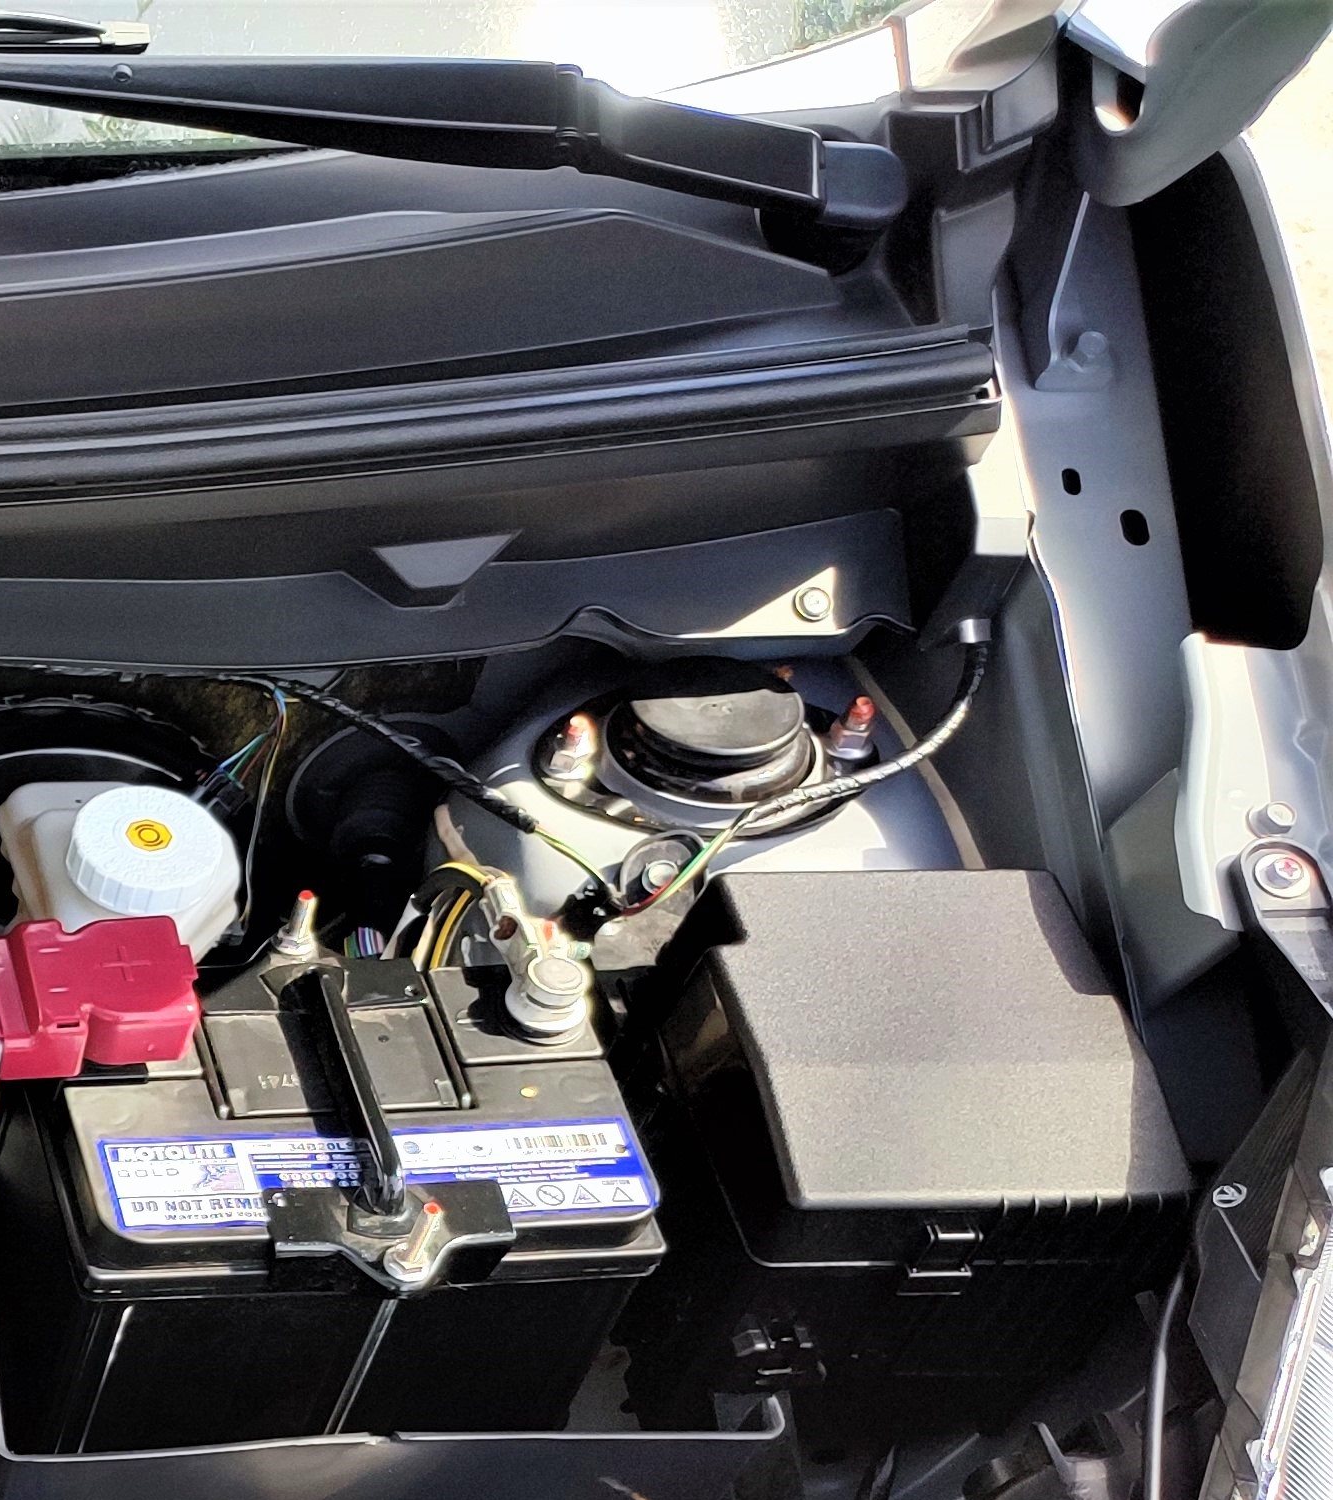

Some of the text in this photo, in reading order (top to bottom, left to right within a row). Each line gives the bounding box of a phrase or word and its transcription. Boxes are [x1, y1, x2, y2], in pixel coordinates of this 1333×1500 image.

[115, 1145, 229, 1162] MOTOLITE
[117, 1168, 180, 1178] GOLD
[131, 1200, 159, 1213] DO
[165, 1199, 203, 1212] NOT
